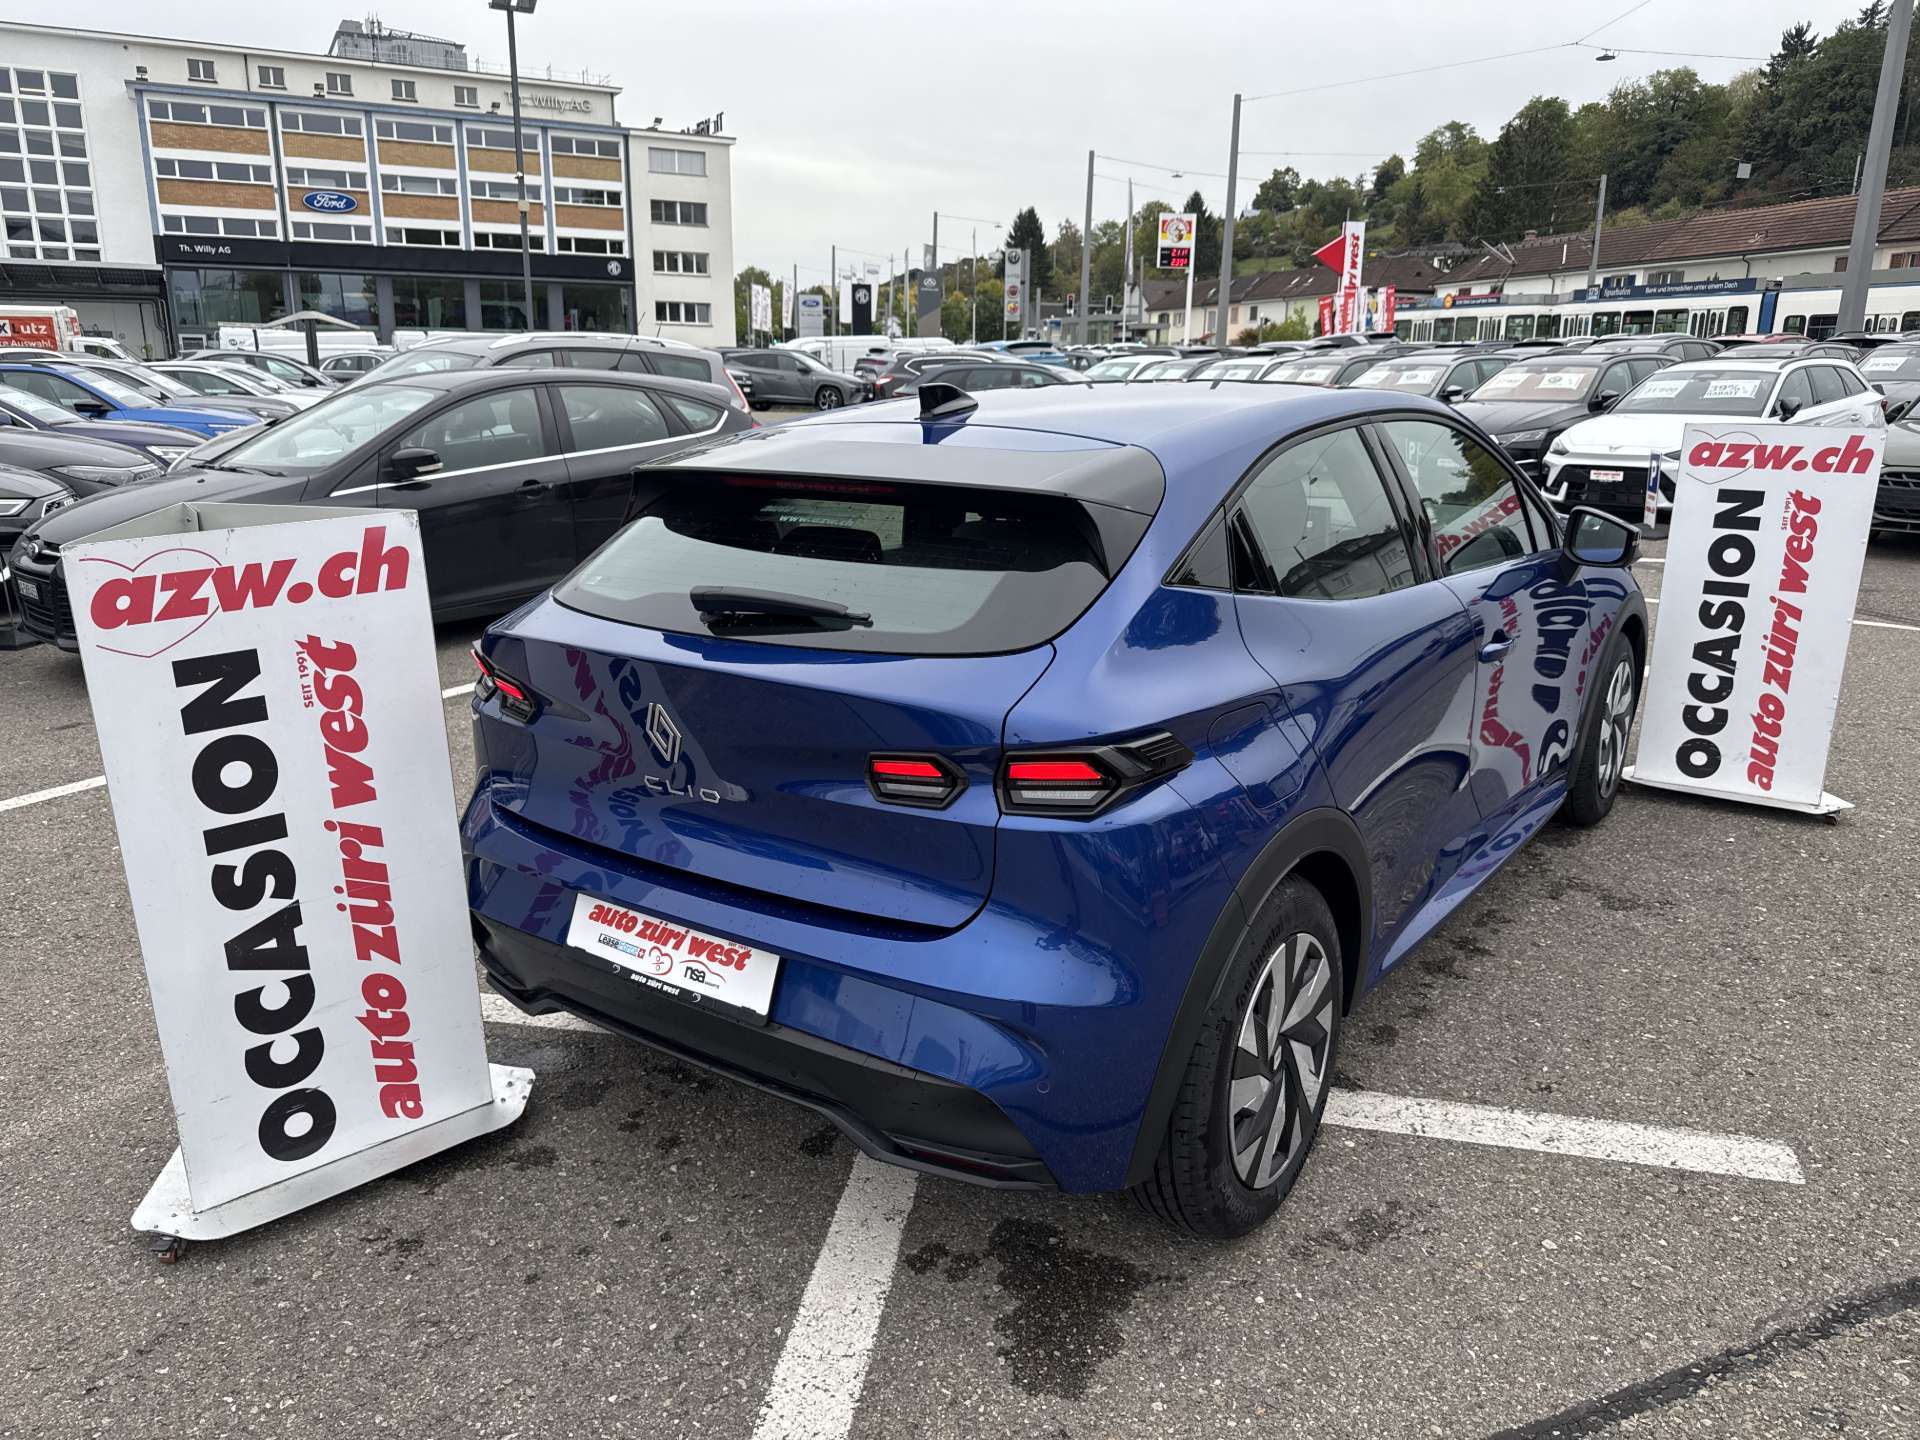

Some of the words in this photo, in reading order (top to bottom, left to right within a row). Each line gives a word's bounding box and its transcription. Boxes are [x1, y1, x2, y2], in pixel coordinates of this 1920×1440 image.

[532, 94, 566, 113] Willy
[569, 99, 592, 112] AG
[313, 193, 347, 209] Ford
[179, 244, 193, 252] Th.
[194, 244, 216, 255] Willy
[217, 246, 231, 254] AG
[1350, 233, 1360, 269] west
[607, 262, 621, 275] MG
[855, 288, 870, 304] MG
[1724, 281, 1738, 289] Dach
[1688, 435, 1875, 474] azw.ch
[1784, 497, 1792, 513] 1991
[1781, 516, 1789, 530] SEIT
[1778, 489, 1822, 593] west
[90, 525, 410, 630] azw.ch
[1674, 488, 1766, 779] OCCASION
[1761, 595, 1803, 695] züri
[296, 651, 310, 679] 1991
[301, 683, 314, 708] SEIT
[294, 634, 378, 809] west
[1747, 692, 1786, 792] auto
[644, 775, 720, 804] CLIO
[171, 648, 337, 1161] OCCASION
[323, 819, 402, 965] züri
[588, 903, 638, 932] auto
[635, 920, 690, 951] züri
[688, 936, 752, 971] west
[630, 973, 648, 985] auto
[647, 976, 663, 991] züri
[662, 983, 680, 996] west
[684, 965, 706, 984] nsa
[354, 973, 424, 1120] auto
